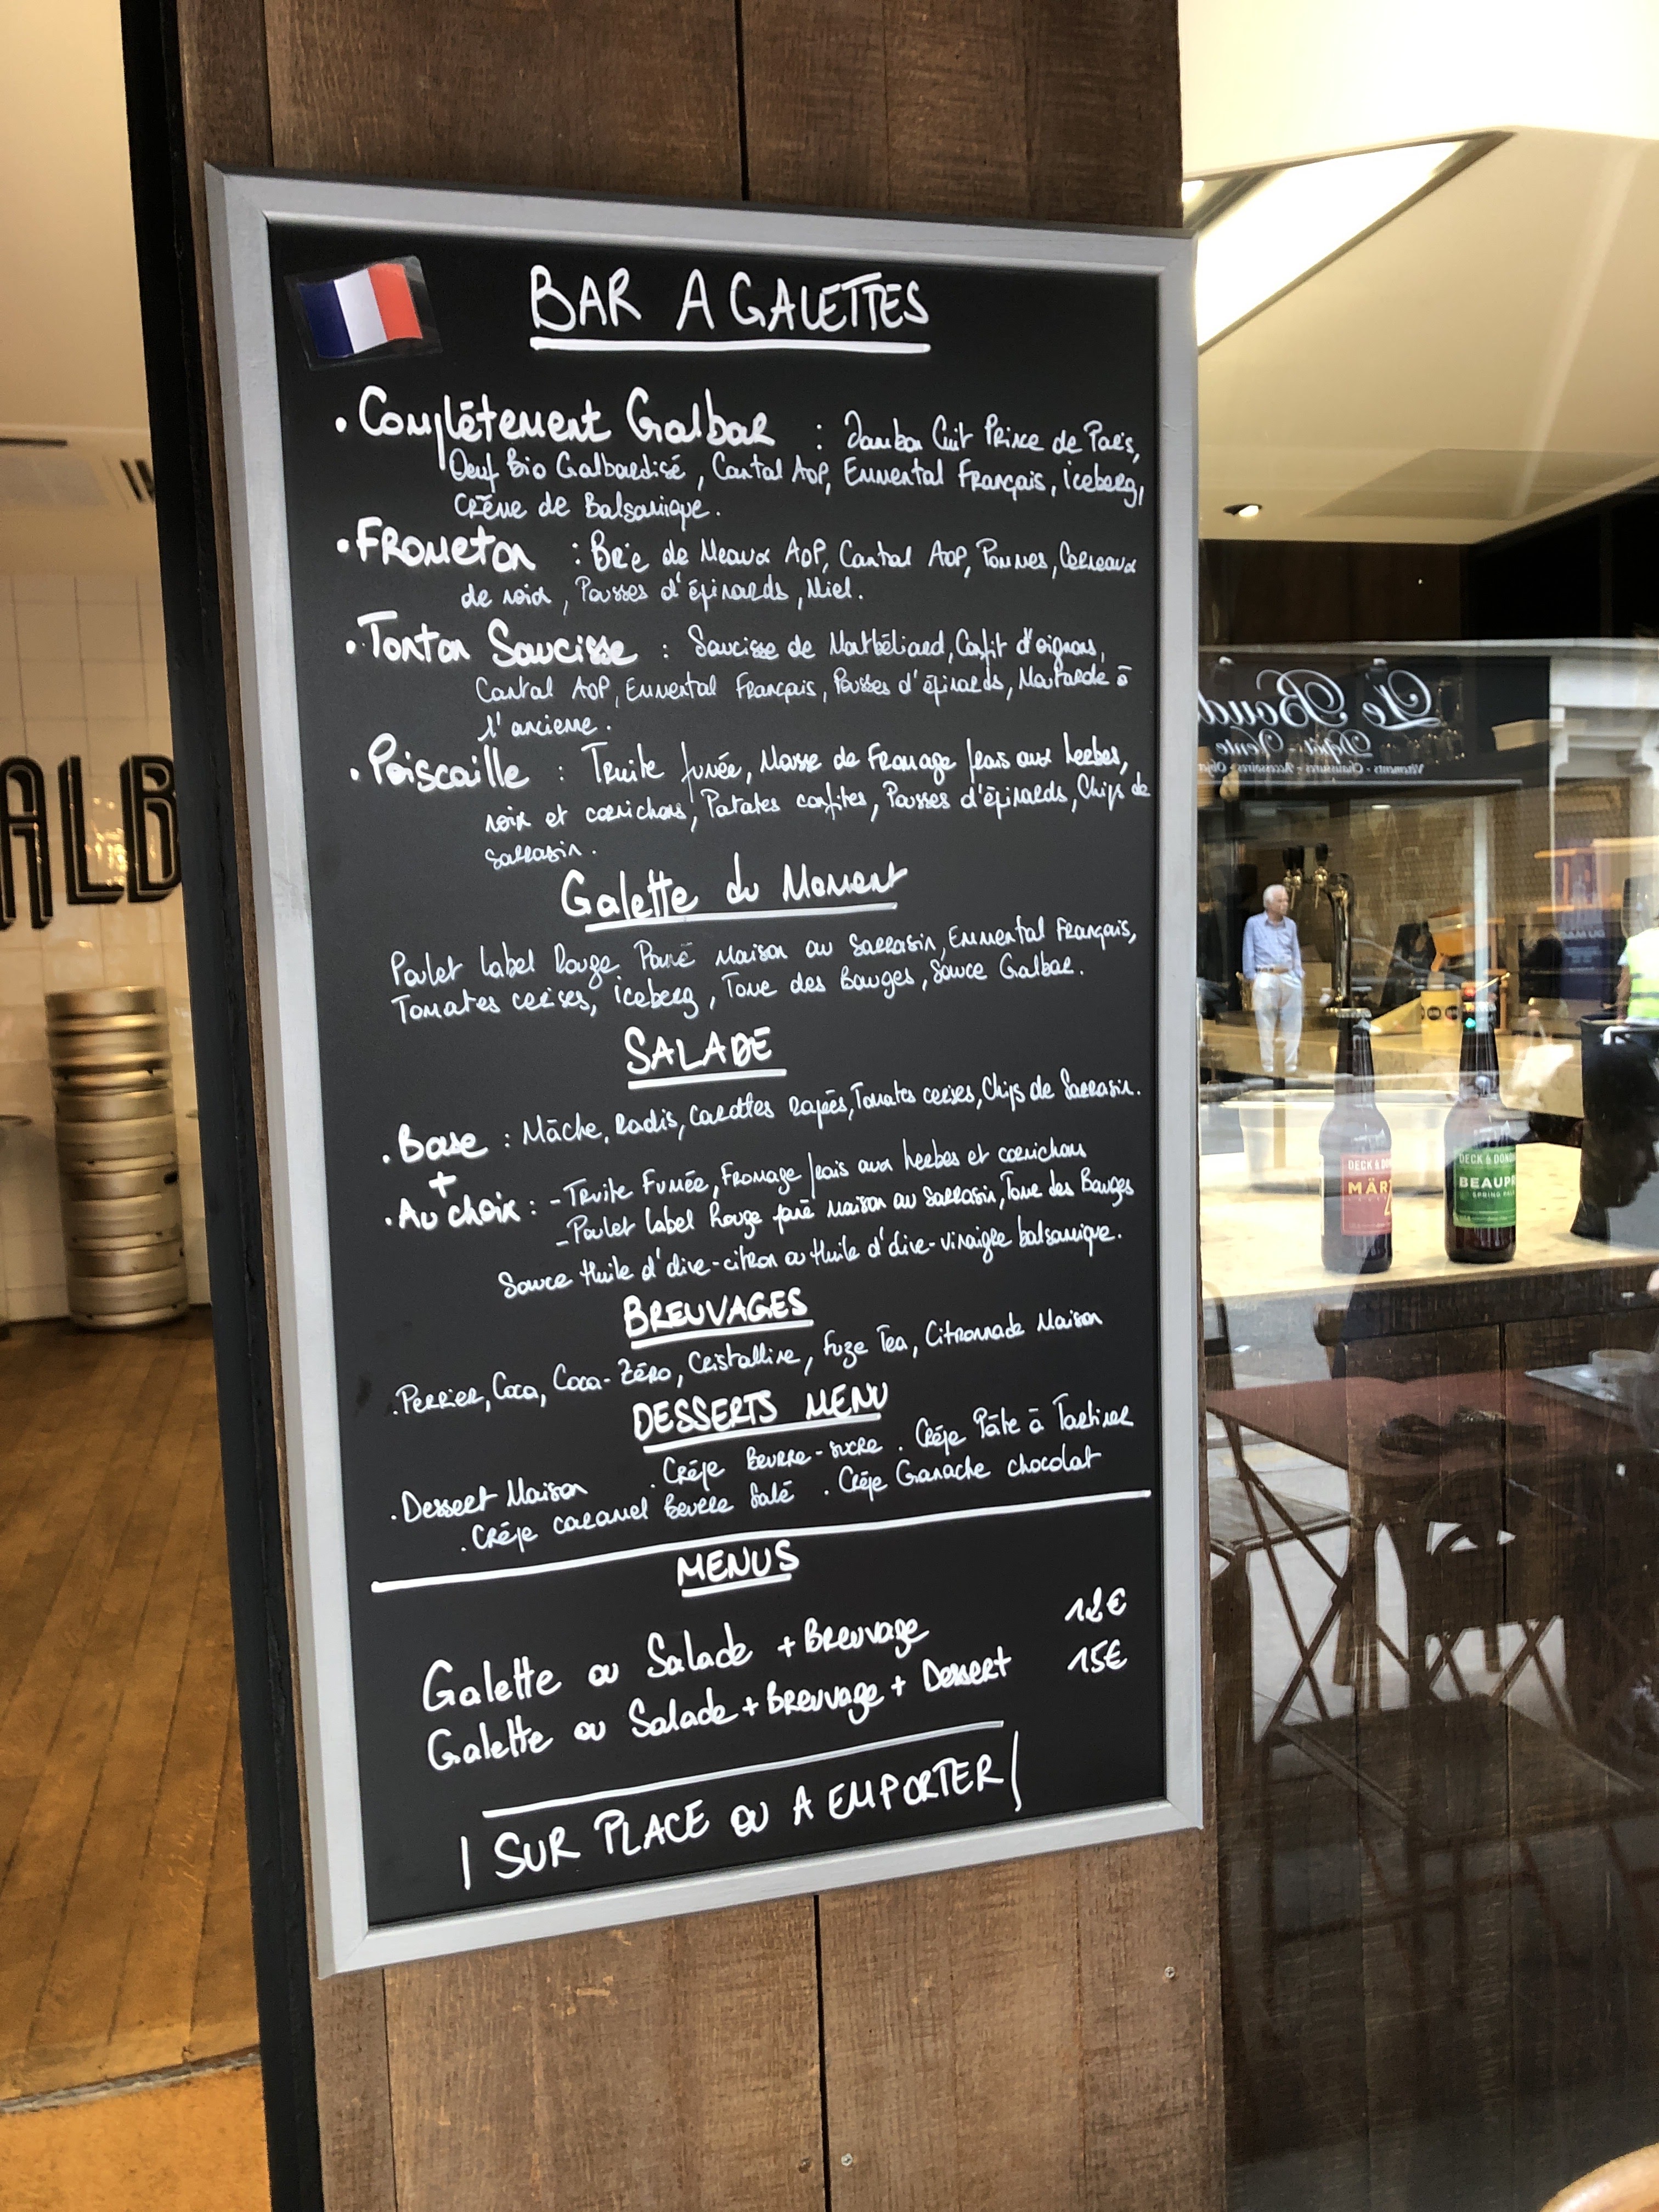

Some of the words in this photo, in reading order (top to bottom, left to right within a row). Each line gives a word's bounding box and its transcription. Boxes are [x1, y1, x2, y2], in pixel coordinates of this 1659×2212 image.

[529, 264, 642, 333] BAR
[675, 268, 716, 332] A
[729, 270, 930, 333] GALETTES
[625, 386, 777, 448] Galbar
[505, 447, 547, 481] Bio
[624, 1025, 774, 1076] SALADE
[623, 1286, 808, 1338] BREUVAGES
[631, 1390, 779, 1442] DESSERTS
[805, 1381, 889, 1422] MENU
[676, 1539, 799, 1586] MENUS
[1064, 1586, 1127, 1624] 12€
[1066, 1638, 1128, 1674] 15€
[493, 1825, 582, 1880] SUR
[592, 1798, 710, 1857] PLACE
[730, 1801, 770, 1838] OU
[792, 1784, 815, 1827] A
[827, 1753, 1005, 1821] EMPORTER
